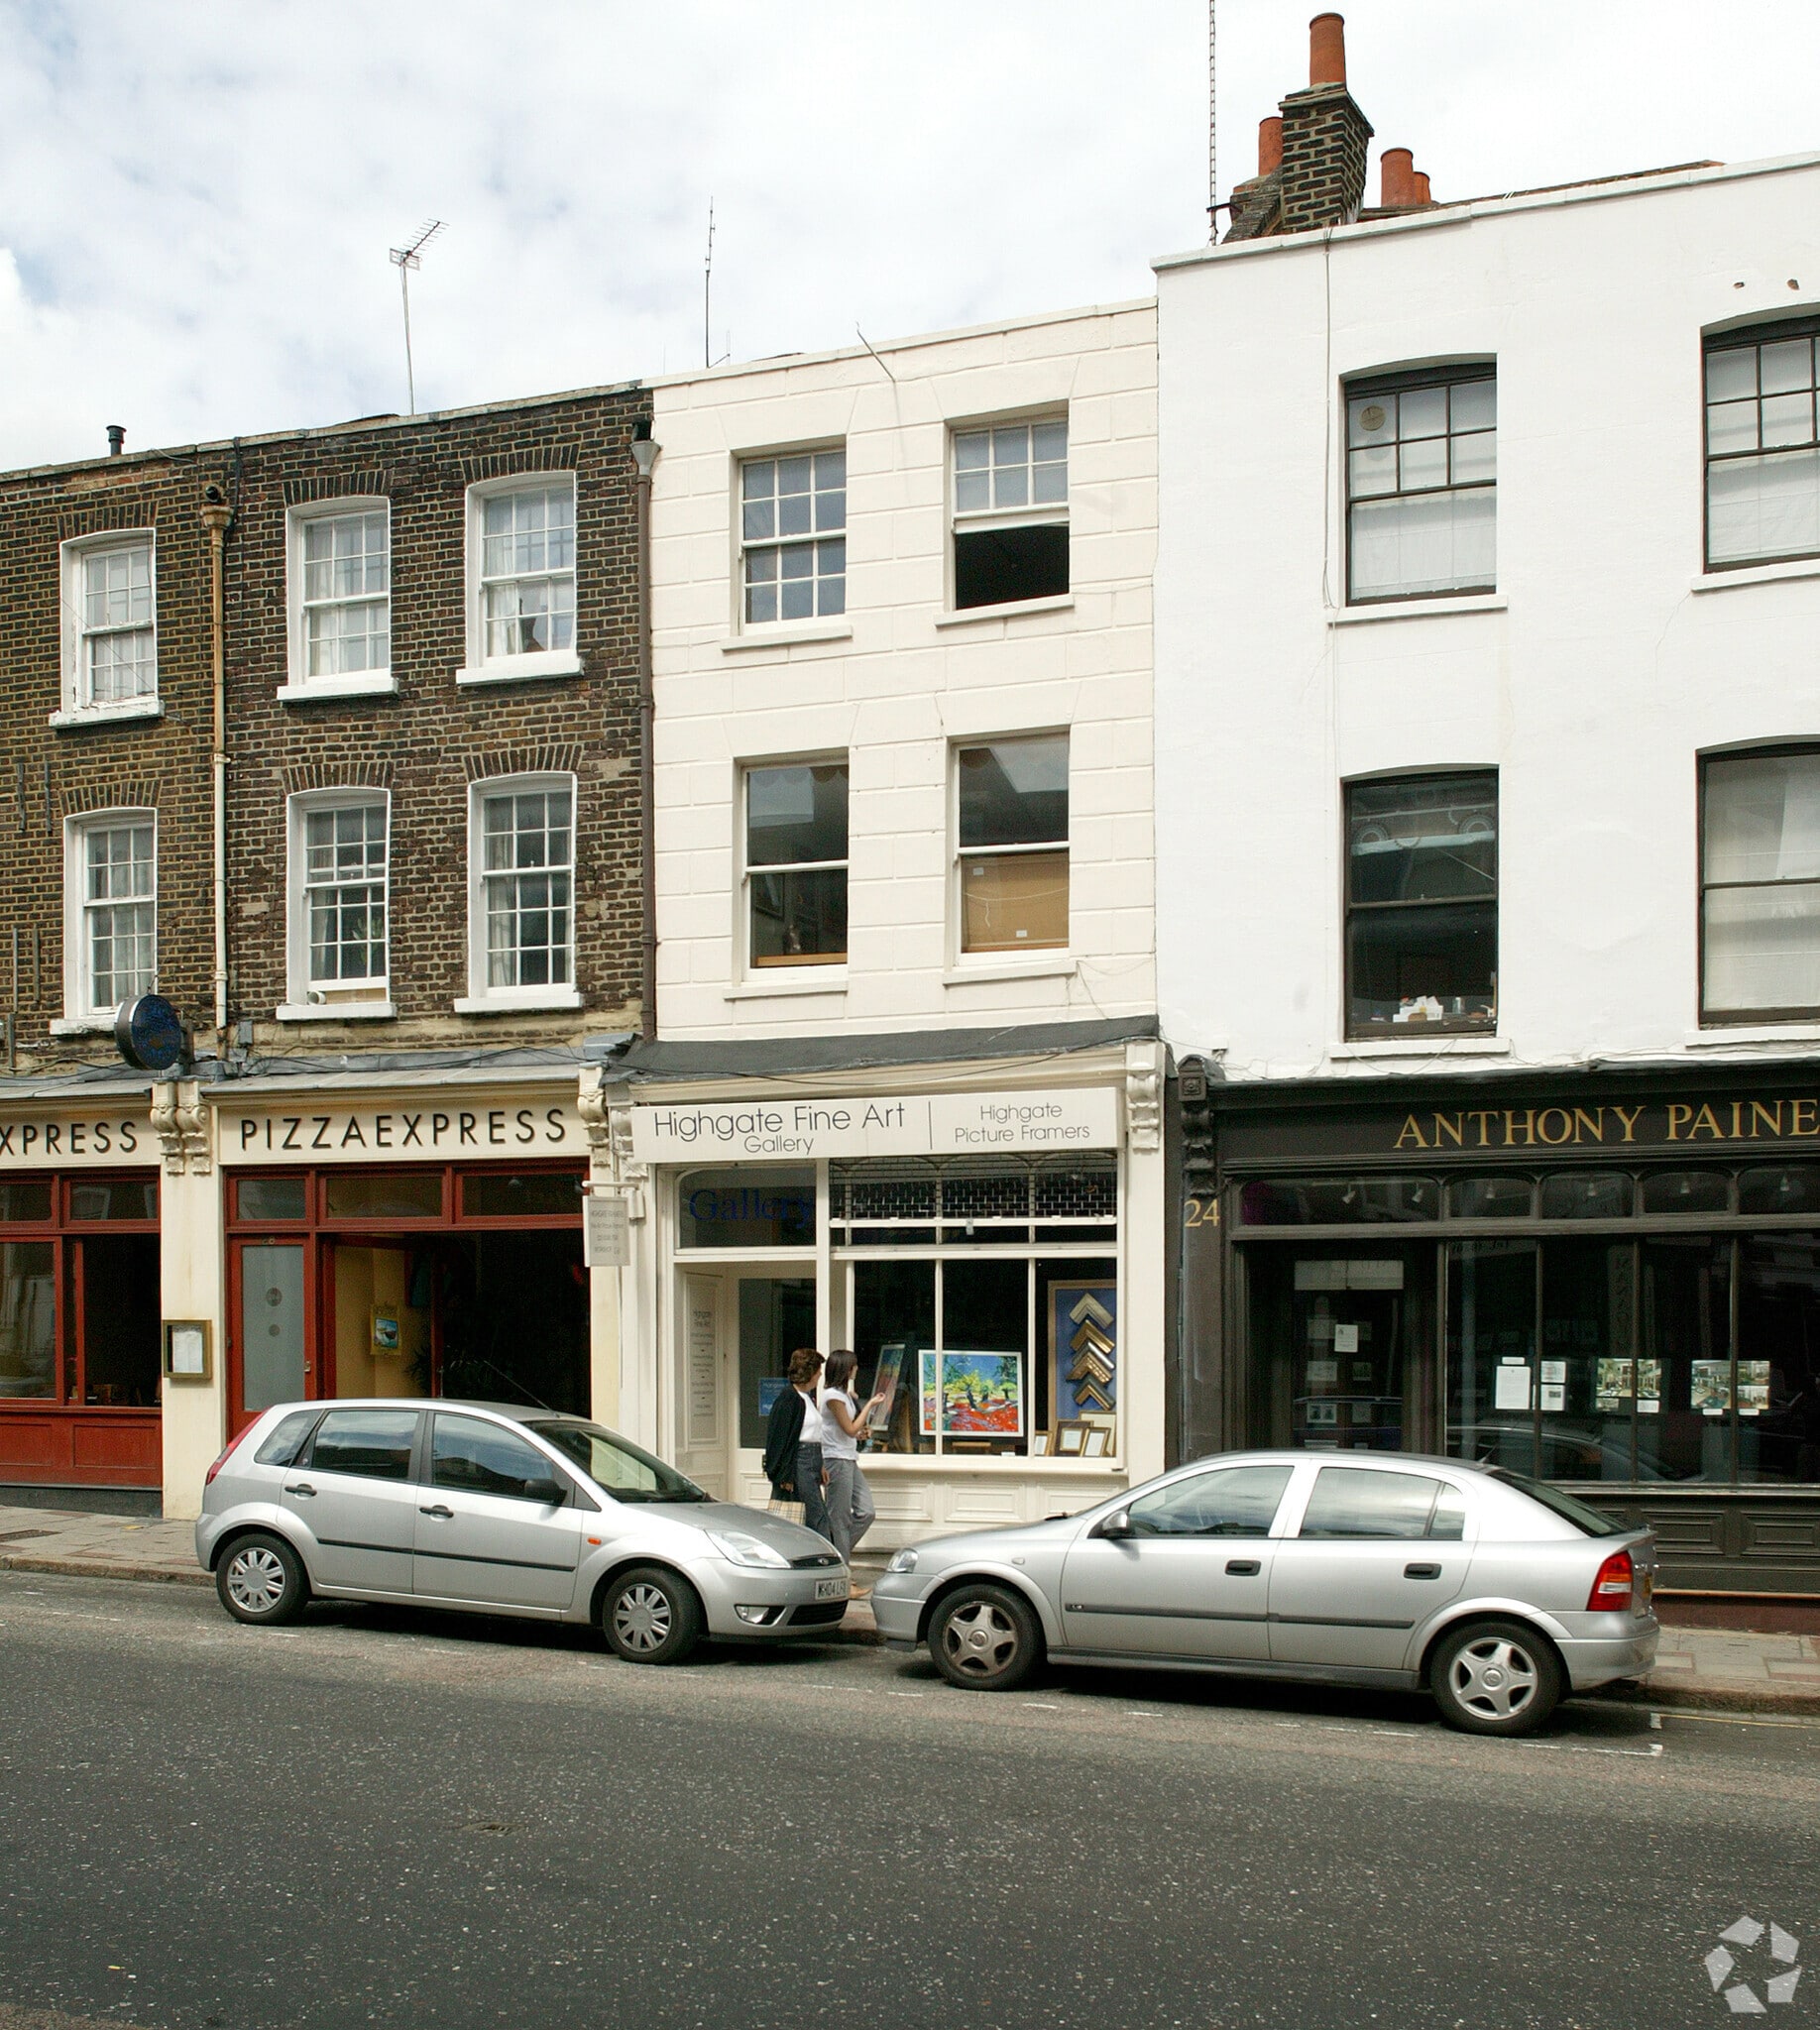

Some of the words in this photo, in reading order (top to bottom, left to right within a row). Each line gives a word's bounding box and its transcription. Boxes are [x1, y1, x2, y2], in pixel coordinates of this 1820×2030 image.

[241, 1109, 566, 1150] PIZZAEXPRESS
[654, 1108, 783, 1142] Highgate
[794, 1105, 851, 1131] Fine
[861, 1101, 905, 1129] Art
[979, 1102, 1063, 1124] Highgate
[1394, 1106, 1645, 1149] ANTHONY
[1665, 1099, 1820, 1140] PAINE
[743, 1135, 815, 1155] Gallery
[955, 1127, 1015, 1143] Picture
[1021, 1125, 1090, 1141] Framers
[689, 1188, 814, 1229] Gallery
[1184, 1199, 1220, 1227] 24
